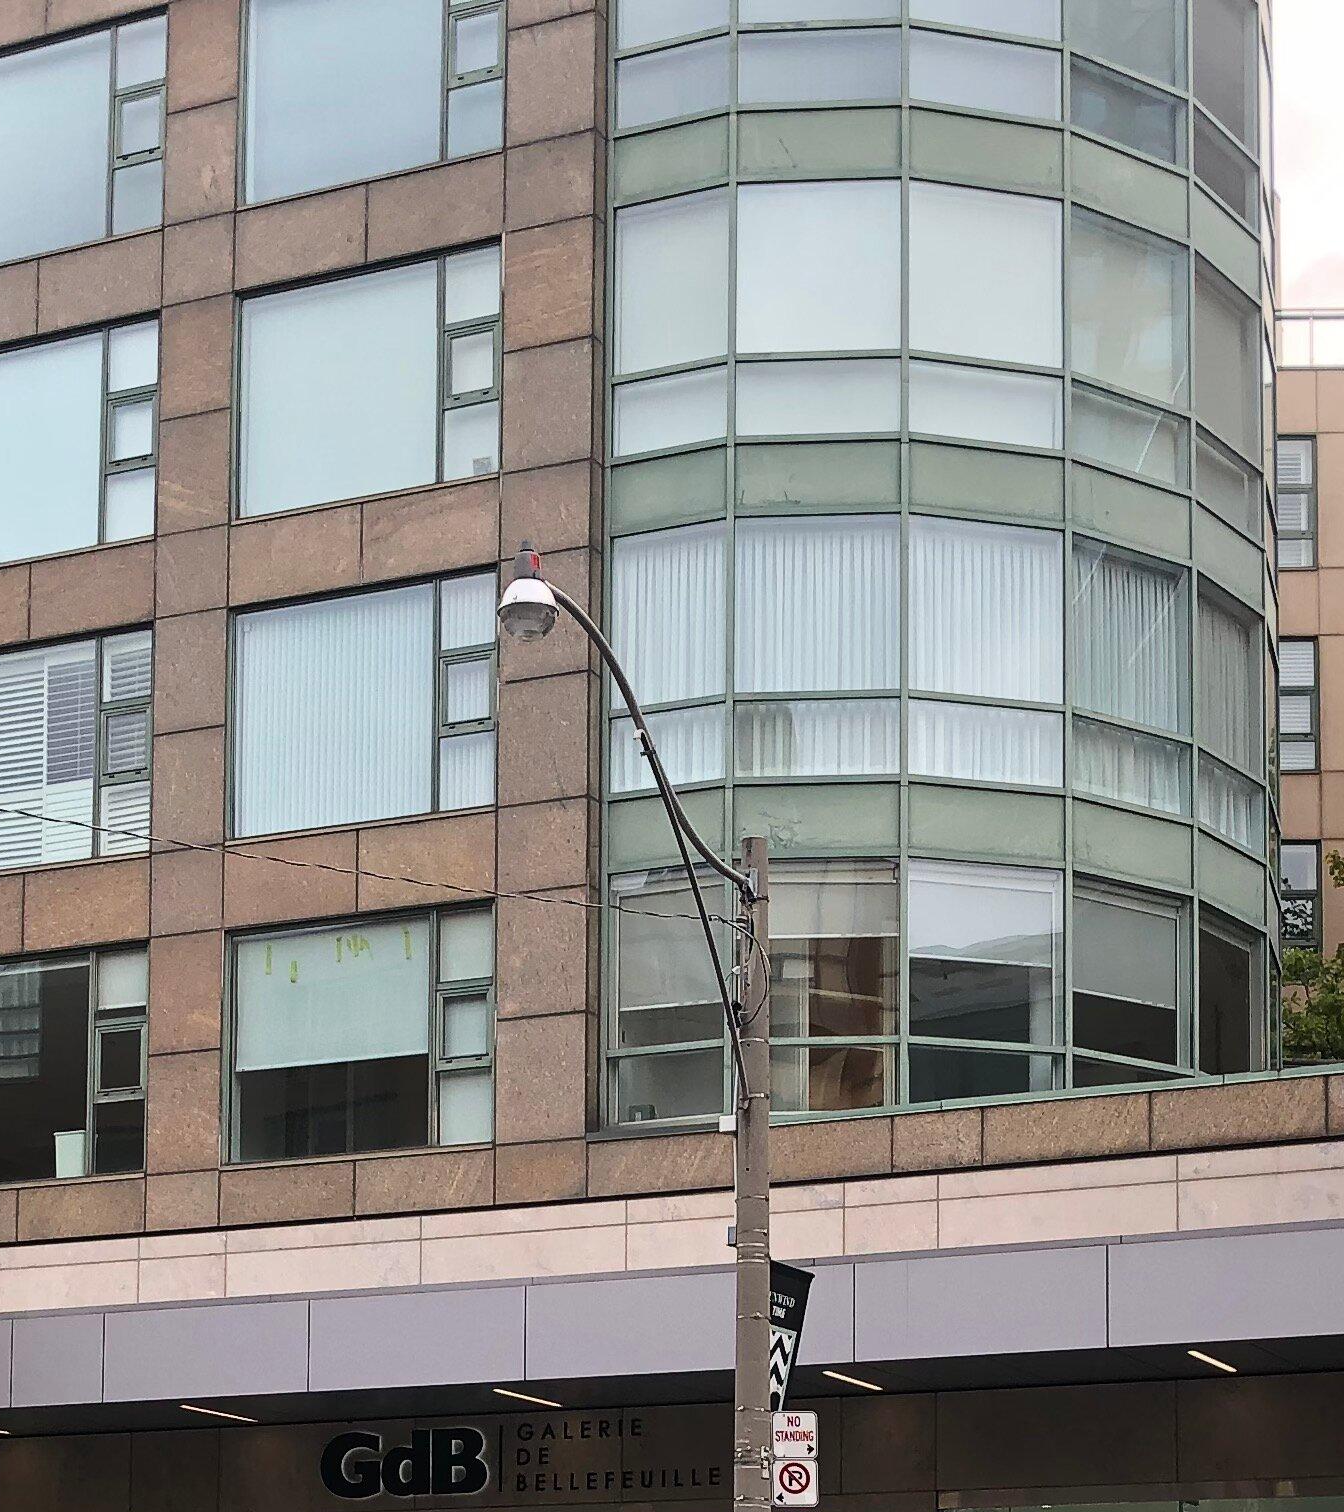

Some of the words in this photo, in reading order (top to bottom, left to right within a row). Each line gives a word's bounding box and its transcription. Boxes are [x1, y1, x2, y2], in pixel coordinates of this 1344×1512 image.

[516, 1418, 643, 1441] GALERIE
[787, 1416, 801, 1427] NO
[775, 1430, 814, 1442] STANDING
[320, 1427, 489, 1499] GdB
[516, 1447, 549, 1466] DE
[516, 1466, 722, 1492] BELLEFEUILLE
